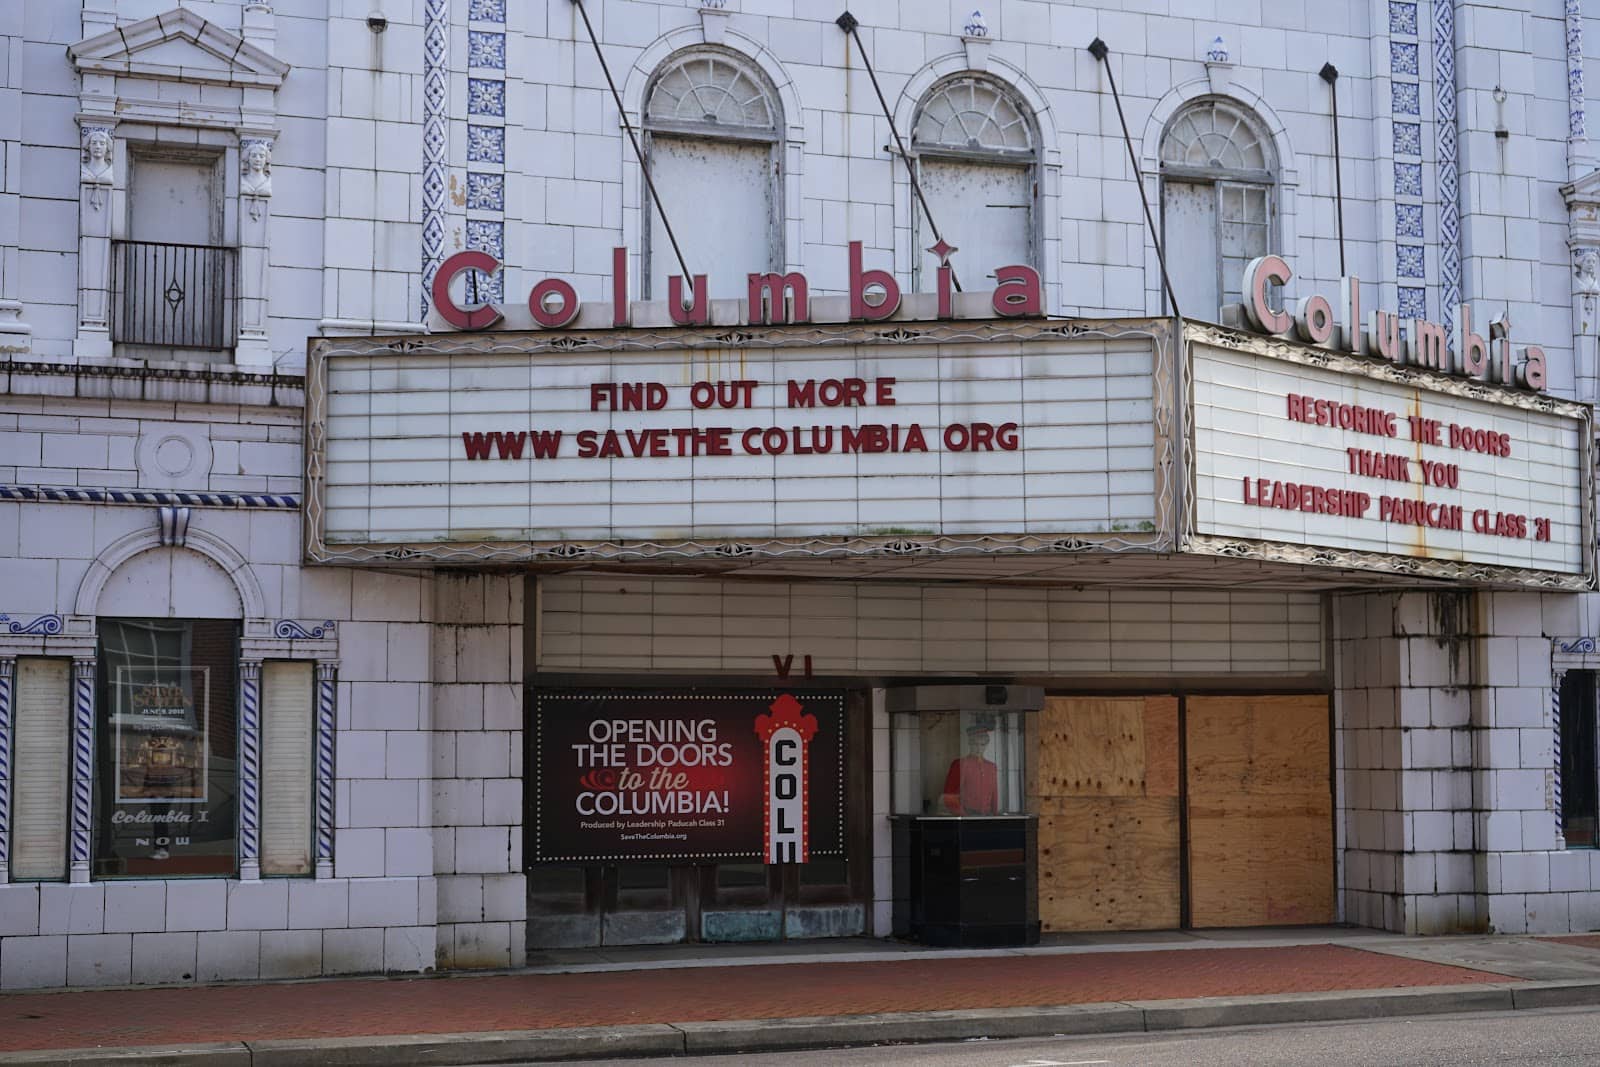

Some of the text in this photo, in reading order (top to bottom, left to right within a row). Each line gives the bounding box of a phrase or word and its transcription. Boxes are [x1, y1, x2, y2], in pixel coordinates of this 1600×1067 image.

[432, 242, 1046, 332] Columbia
[1242, 254, 1547, 391] Columbia
[590, 376, 896, 412] FIND OUT MORE
[1287, 393, 1512, 457] RESTORING THE DOORS
[463, 431, 562, 460] WWW
[943, 422, 1019, 452] ORG
[1347, 447, 1459, 489] THANK YOU
[1243, 476, 1551, 542] LEADERSHIP PADUCAH CLASS 31
[588, 719, 717, 743] OPENING
[571, 742, 733, 768] THE DOORS
[617, 767, 689, 790] to the
[112, 810, 192, 825] Columbia
[575, 790, 730, 816] COLUMBIA!
[580, 818, 726, 830] Produced by Leadership Paducah Class 31
[620, 833, 688, 841] SaveTheColumbia.org
